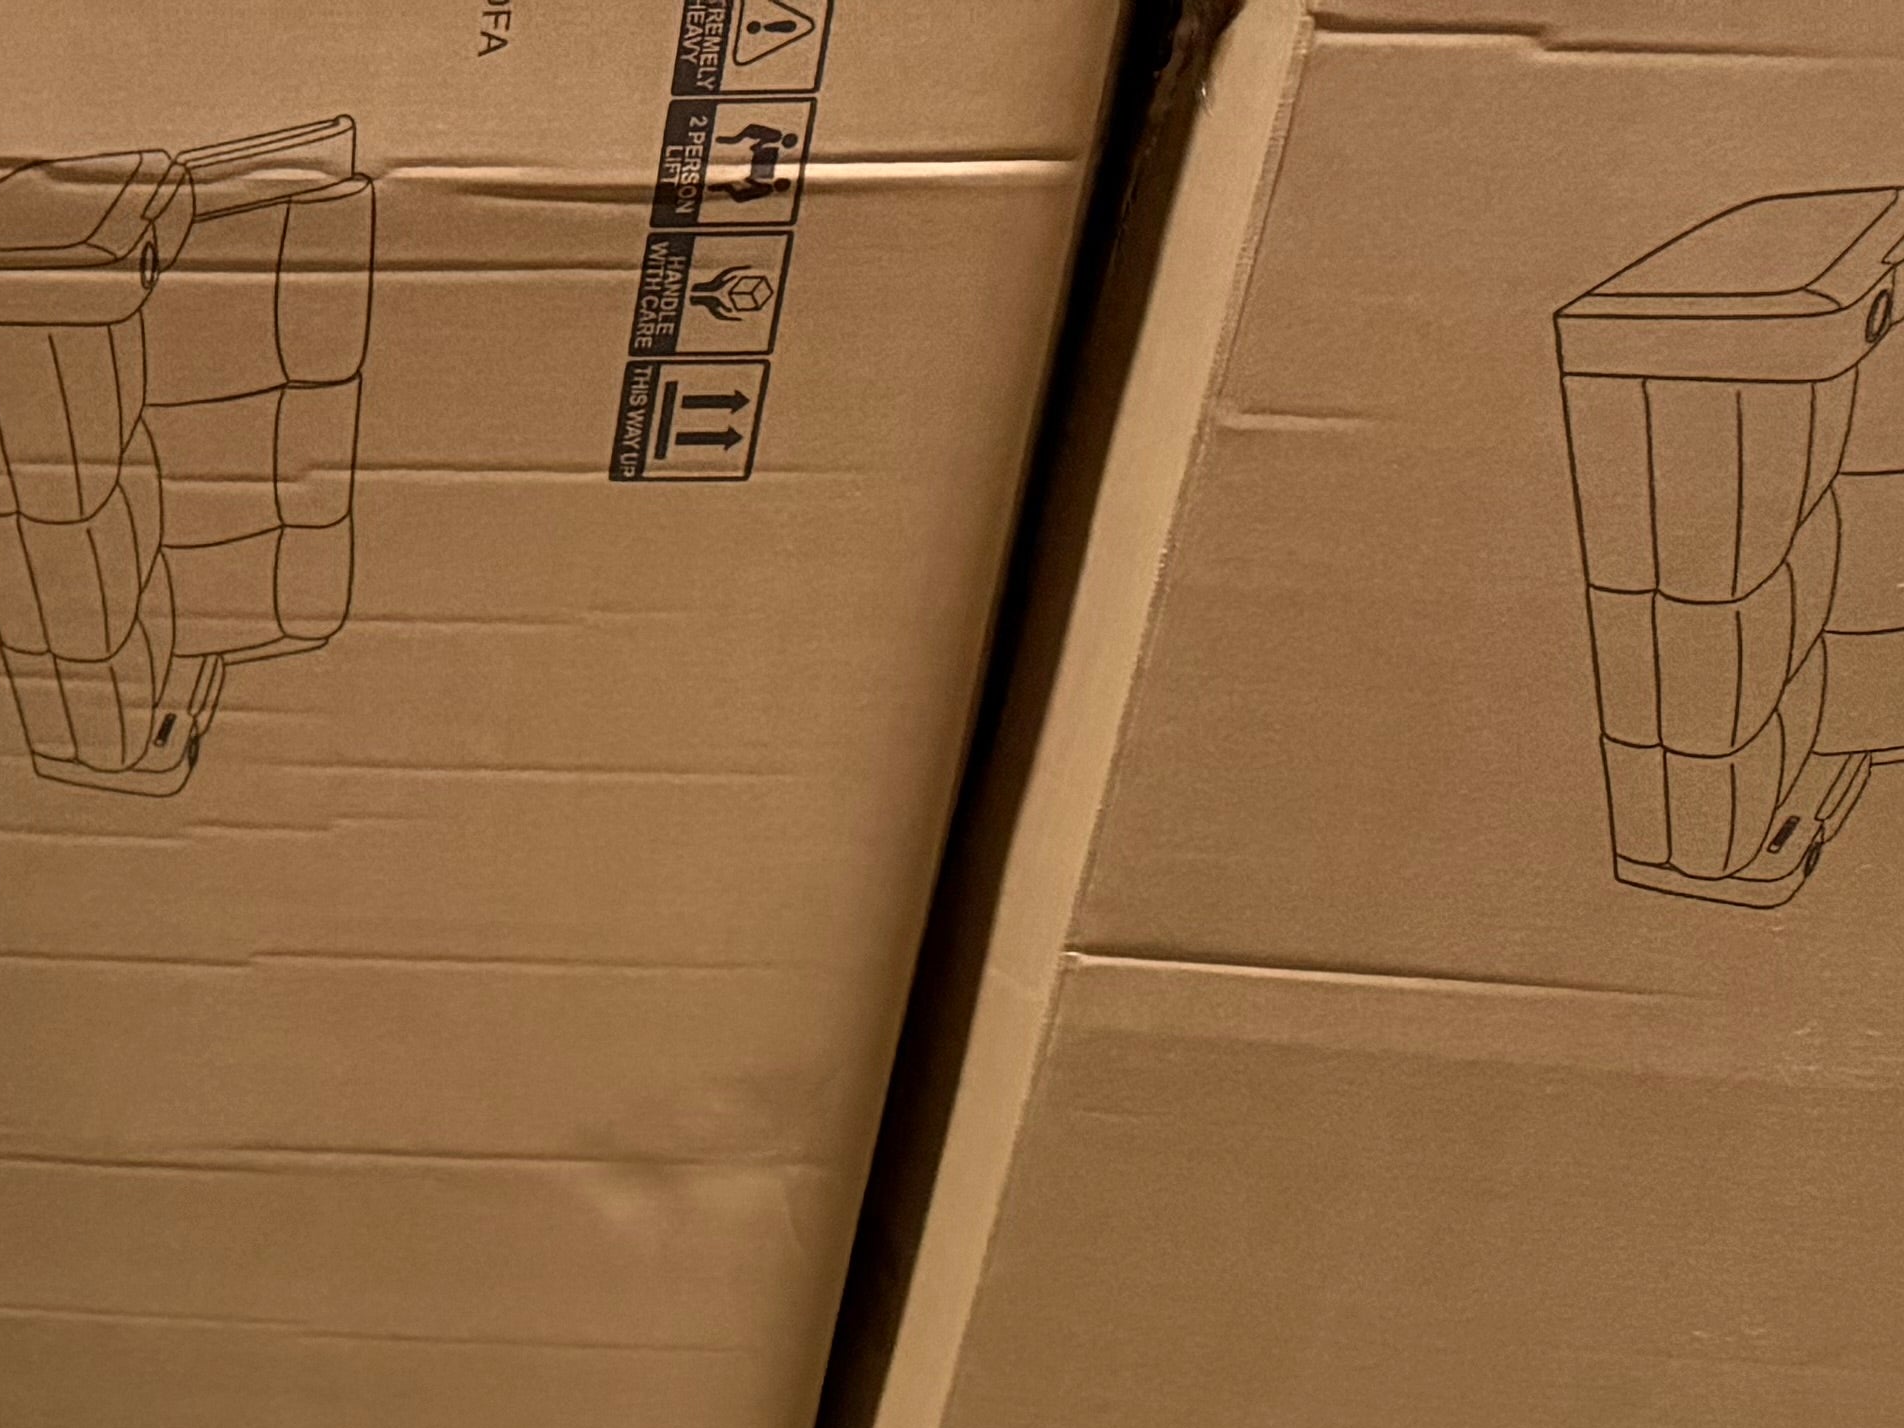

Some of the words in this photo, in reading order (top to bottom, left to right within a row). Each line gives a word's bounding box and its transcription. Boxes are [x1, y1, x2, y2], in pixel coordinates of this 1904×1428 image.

[477, 0, 512, 57] FA
[689, 115, 708, 127] 2
[660, 145, 683, 187] LIFT
[675, 131, 706, 214] PERSON
[643, 241, 669, 290] WITH
[656, 256, 686, 335] HANDLE
[634, 295, 660, 349] CARE
[629, 365, 652, 407] THIS
[623, 409, 645, 450] WAY
[620, 453, 639, 477] UP
